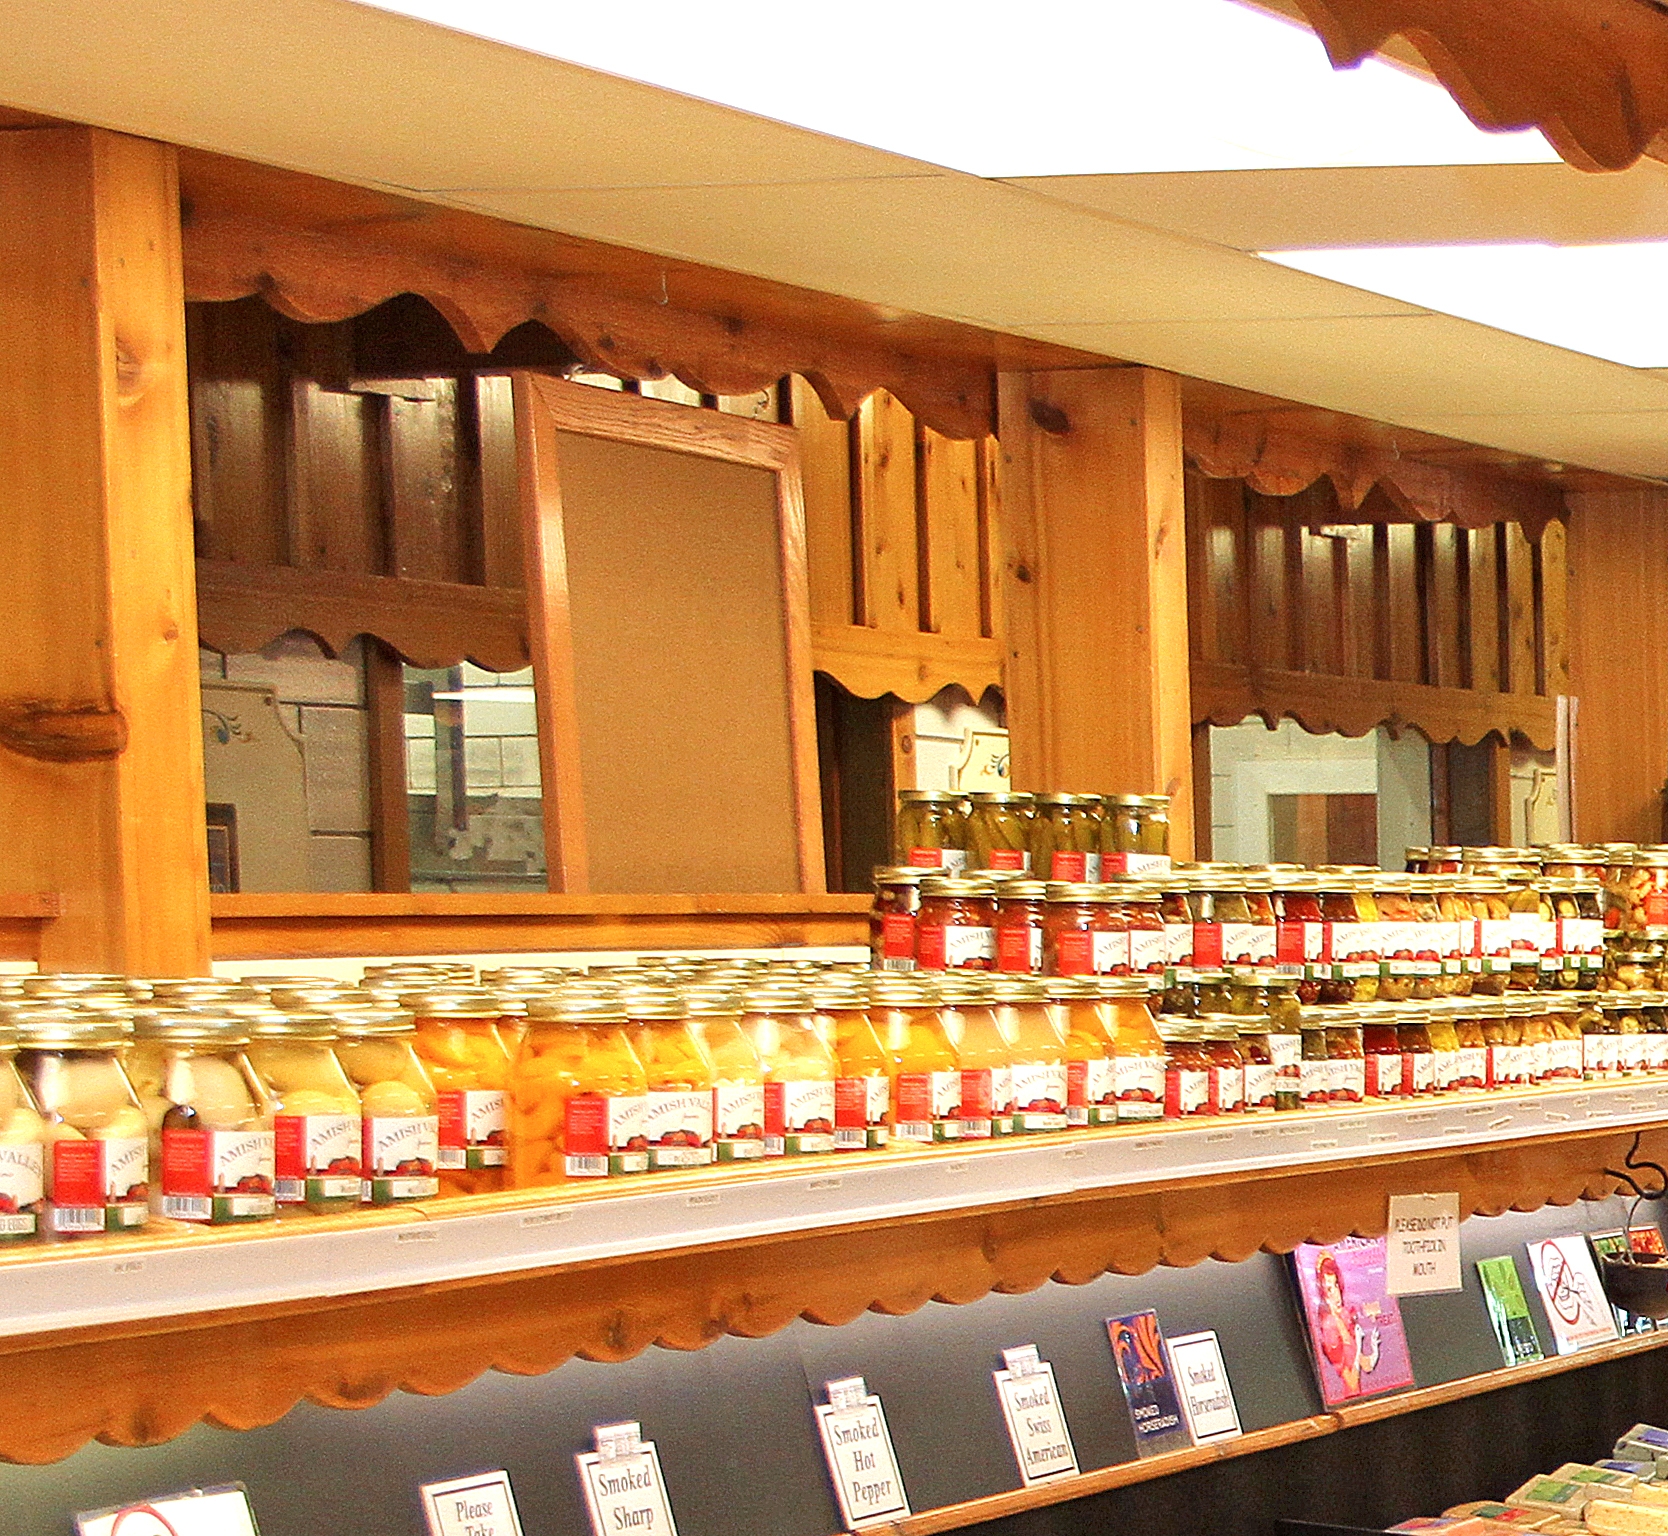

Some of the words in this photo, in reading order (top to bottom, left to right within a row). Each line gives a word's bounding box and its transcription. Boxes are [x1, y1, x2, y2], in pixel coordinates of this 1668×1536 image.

[1187, 1361, 1216, 1387] Smoked
[1014, 1386, 1050, 1412] Smoked
[1134, 1404, 1161, 1420] SMOKED
[833, 1416, 880, 1447] Smoked
[1026, 1416, 1052, 1437] Swiss
[1138, 1414, 1180, 1434] HORSERADISH
[853, 1450, 876, 1473] Hot
[1025, 1441, 1068, 1467] American
[598, 1464, 652, 1497] Smoked
[852, 1478, 892, 1506] Pepper
[455, 1500, 493, 1522] Please
[613, 1505, 654, 1531] Sharp
